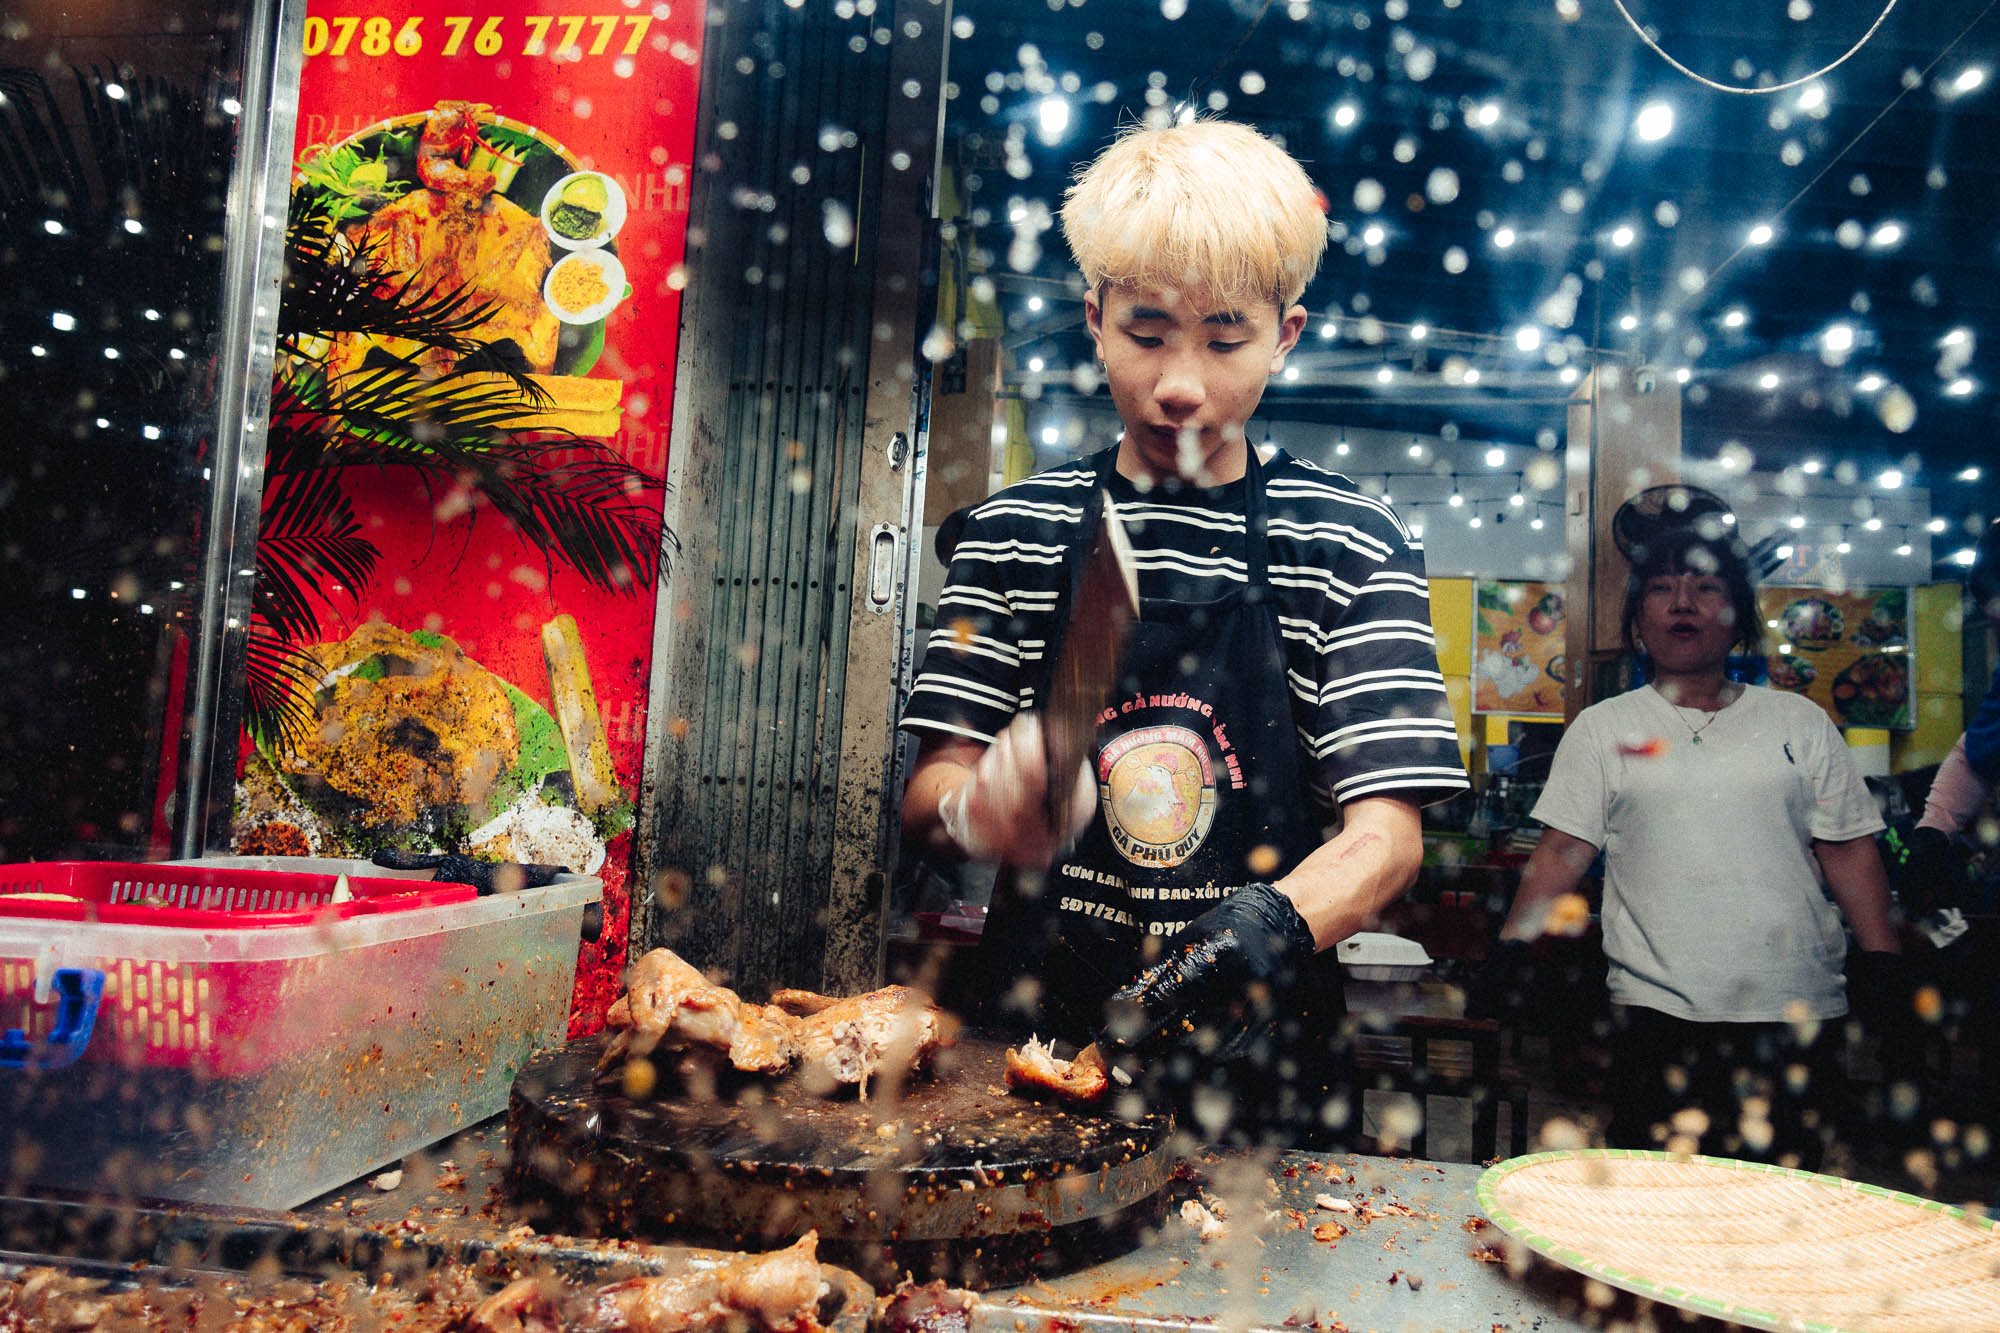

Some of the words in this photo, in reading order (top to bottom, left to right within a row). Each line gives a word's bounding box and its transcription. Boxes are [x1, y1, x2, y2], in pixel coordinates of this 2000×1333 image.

[302, 16, 424, 57] 0786
[441, 16, 504, 57] 76
[521, 15, 654, 56] 7777
[306, 107, 389, 146] PH
[1121, 691, 1147, 714] GÀ
[1149, 691, 1214, 719] NƯỚNG
[1111, 825, 1129, 850] GÀ
[1130, 843, 1171, 862] PHÚ
[1061, 863, 1095, 881] CƠM
